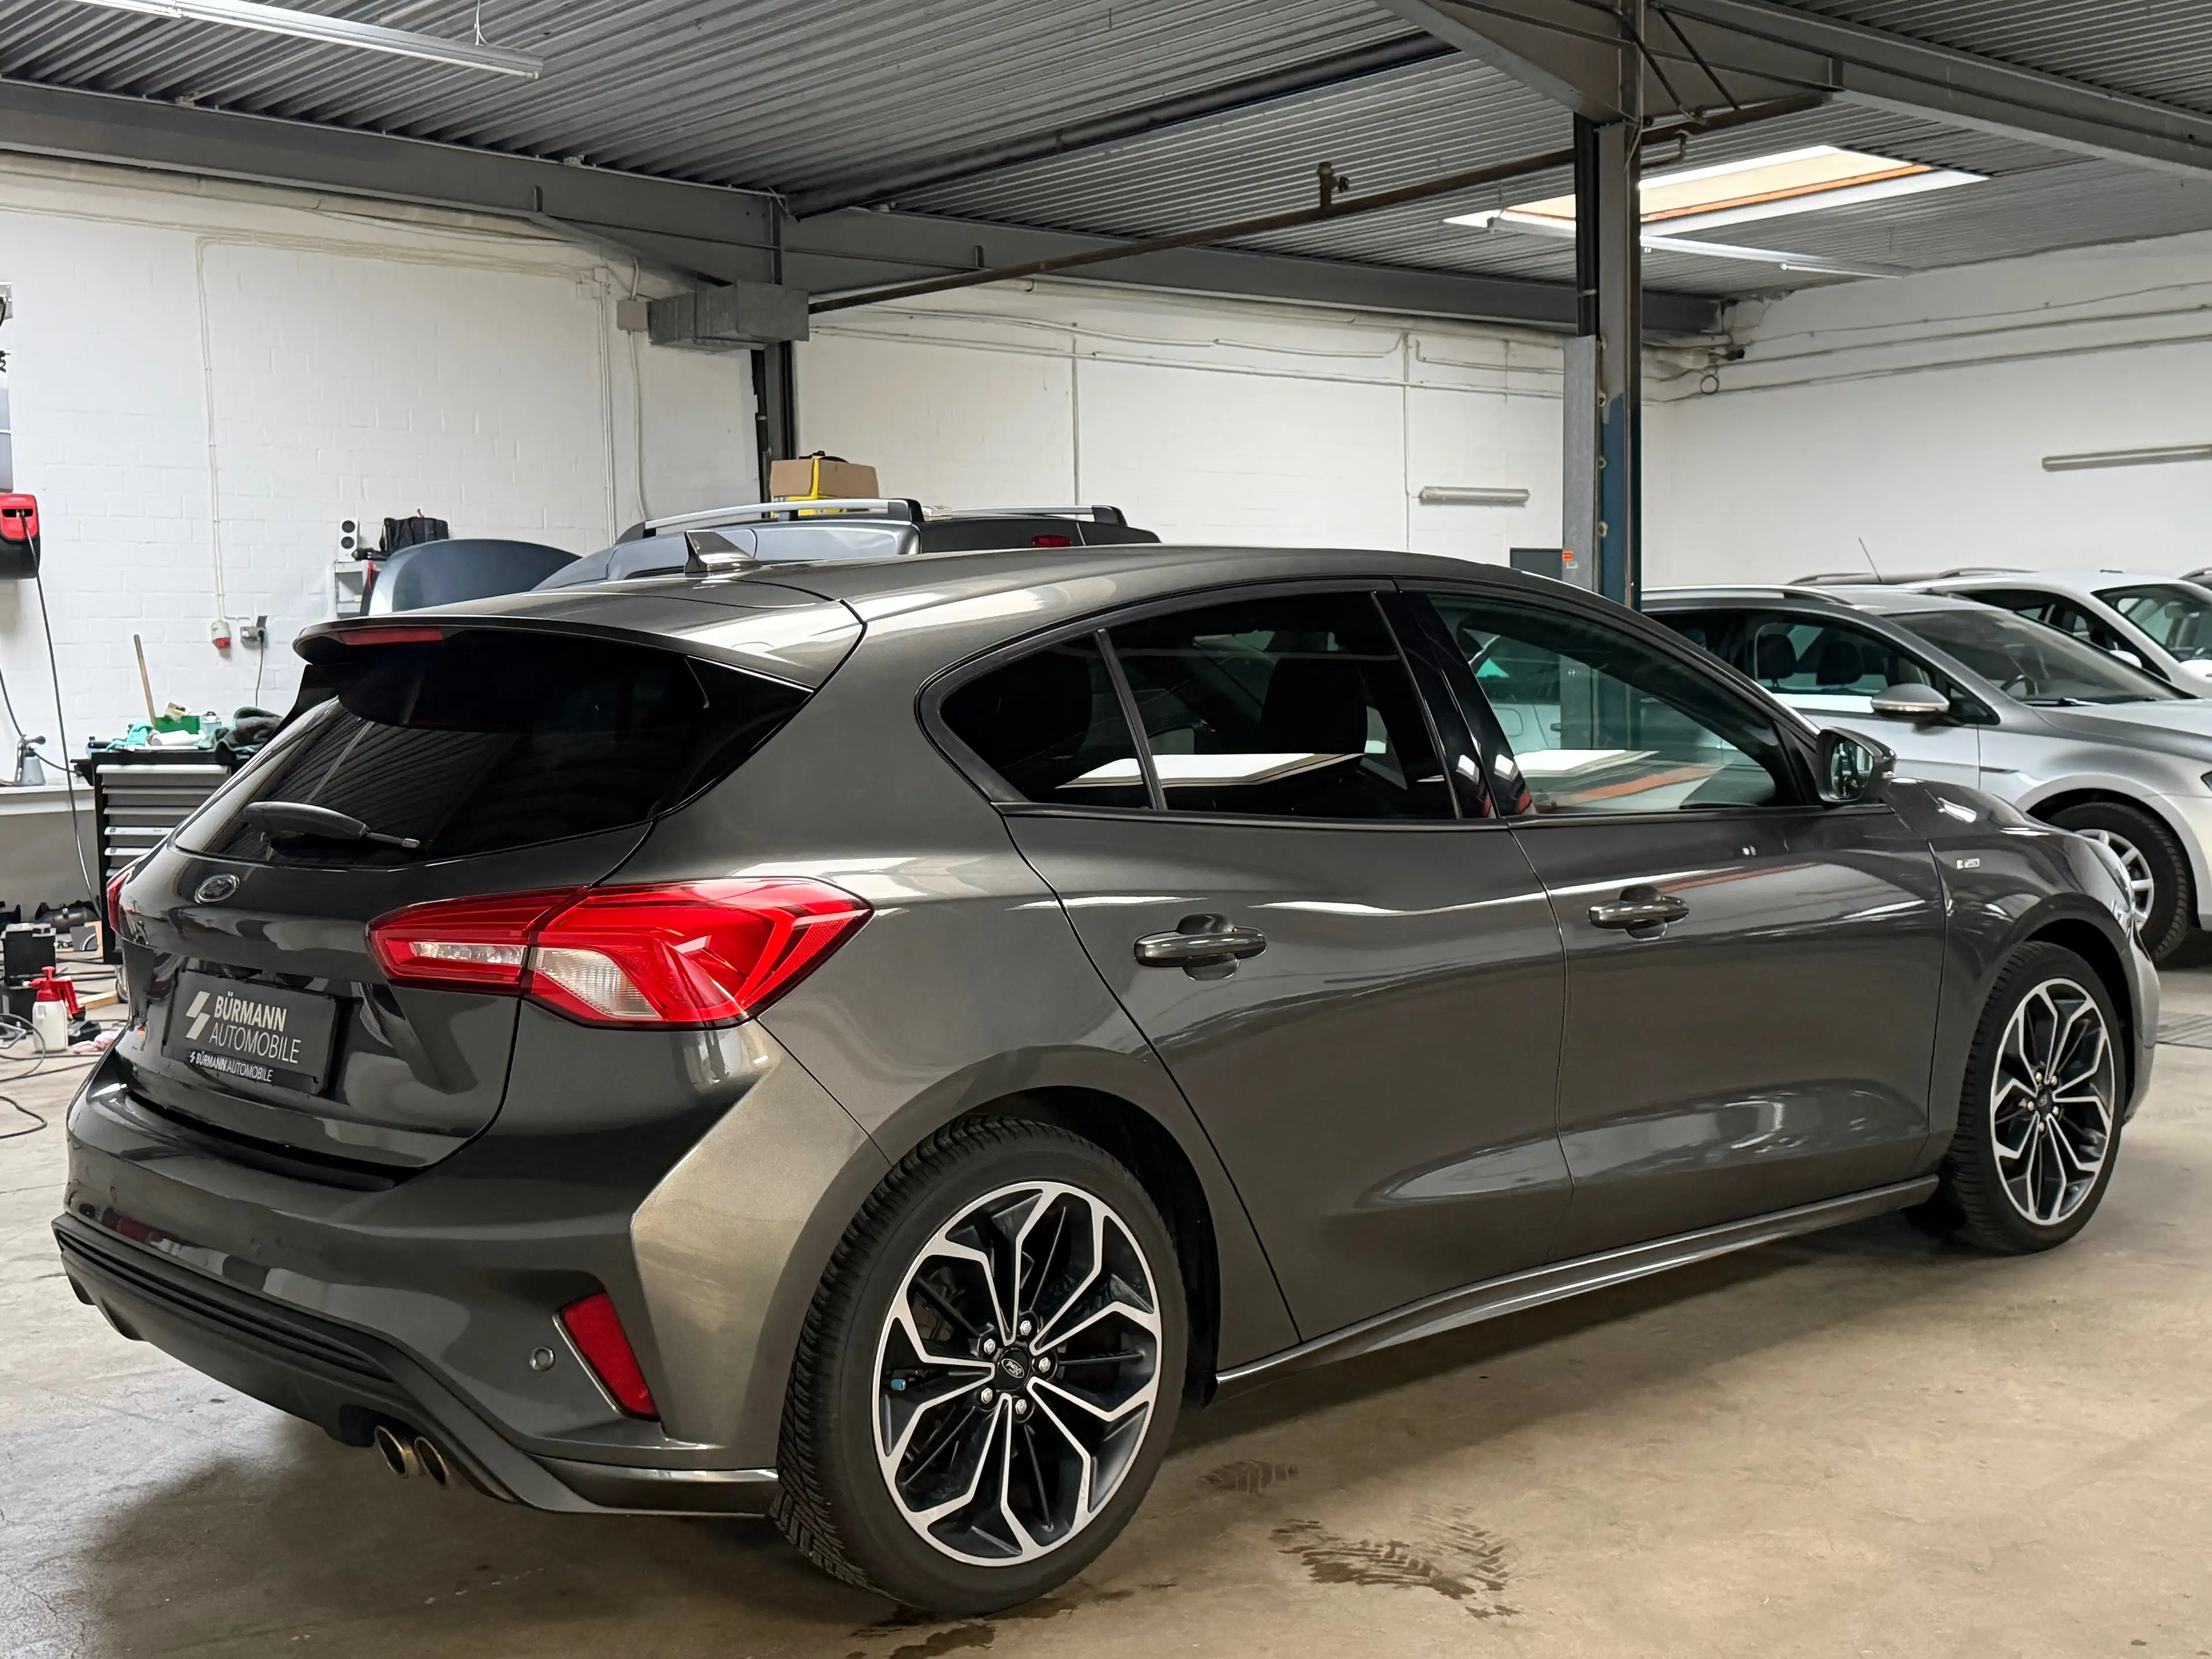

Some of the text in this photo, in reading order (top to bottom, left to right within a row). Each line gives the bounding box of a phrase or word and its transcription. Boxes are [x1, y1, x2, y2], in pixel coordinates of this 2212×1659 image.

[214, 991, 287, 1032] BÜRMANN
[209, 1022, 301, 1063] AUTOMOBILE
[196, 1052, 273, 1082] BÜRMANN AUTOMOBILE
[1006, 1361, 1022, 1376] Ford
